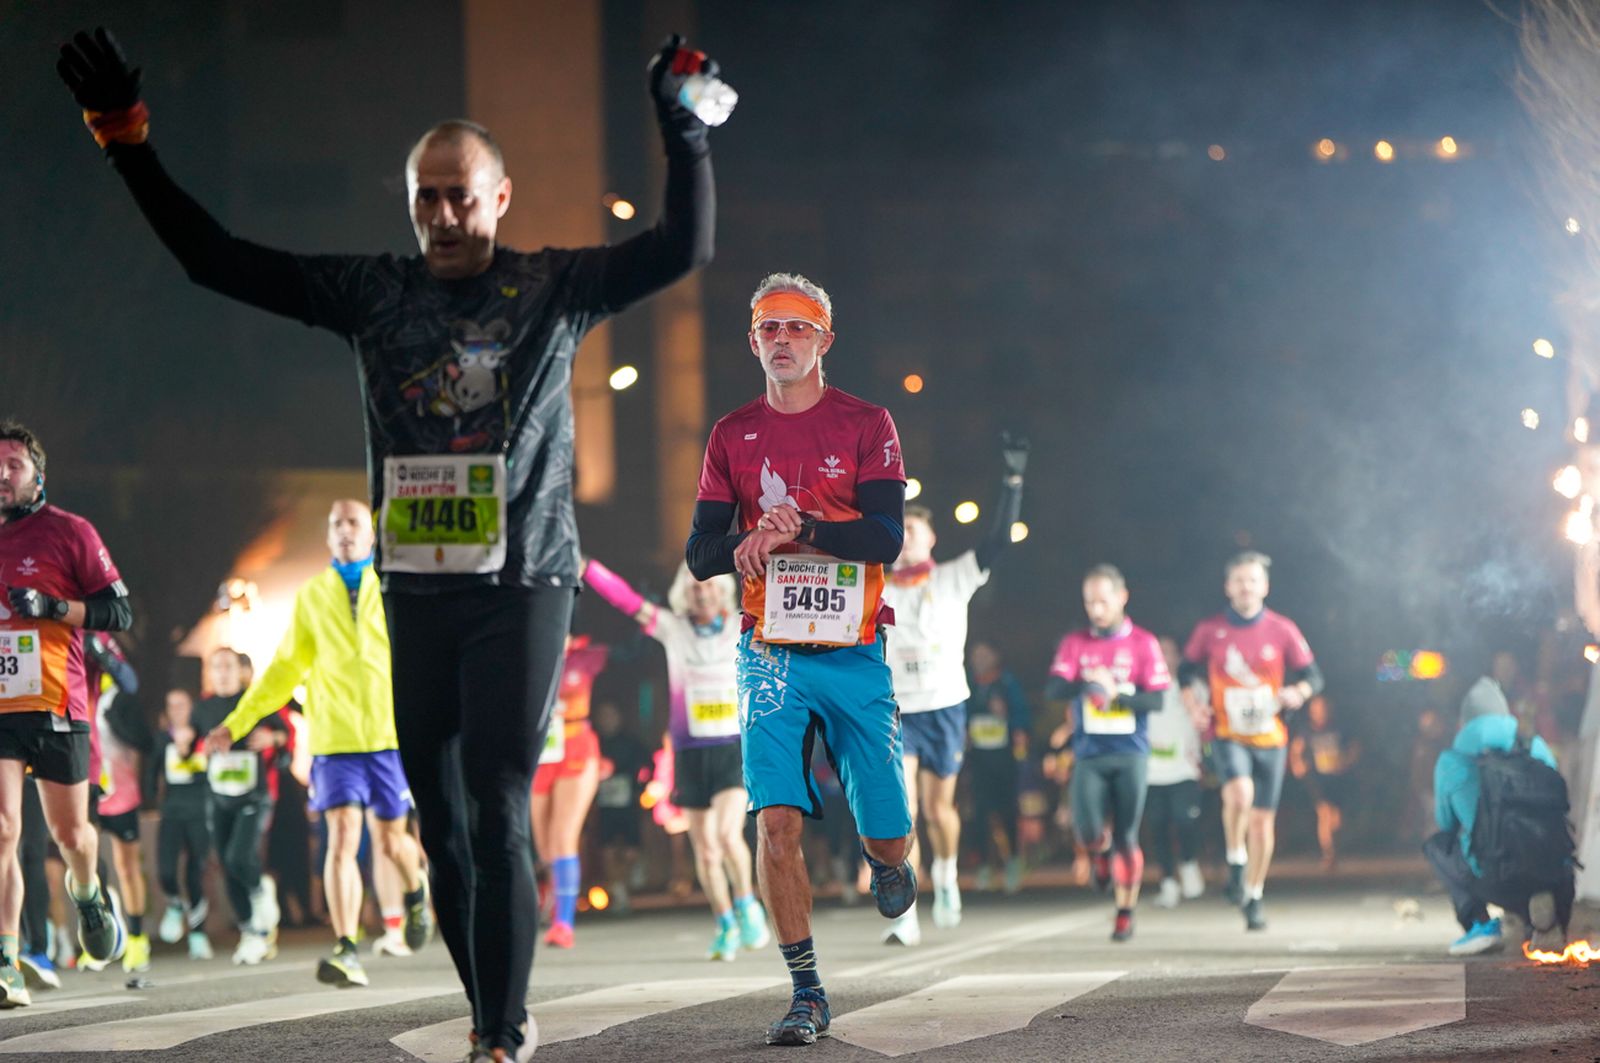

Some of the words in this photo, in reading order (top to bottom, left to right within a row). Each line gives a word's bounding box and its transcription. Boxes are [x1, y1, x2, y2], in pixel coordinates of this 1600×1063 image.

[407, 498, 477, 532] 1446
[788, 564, 816, 573] NOCHE
[817, 566, 829, 574] DE
[777, 574, 796, 585] SAN
[797, 573, 829, 586] ANTÓN
[783, 586, 846, 612] 5495
[785, 612, 819, 620] FRANCISCO
[820, 613, 841, 621] JAVIER
